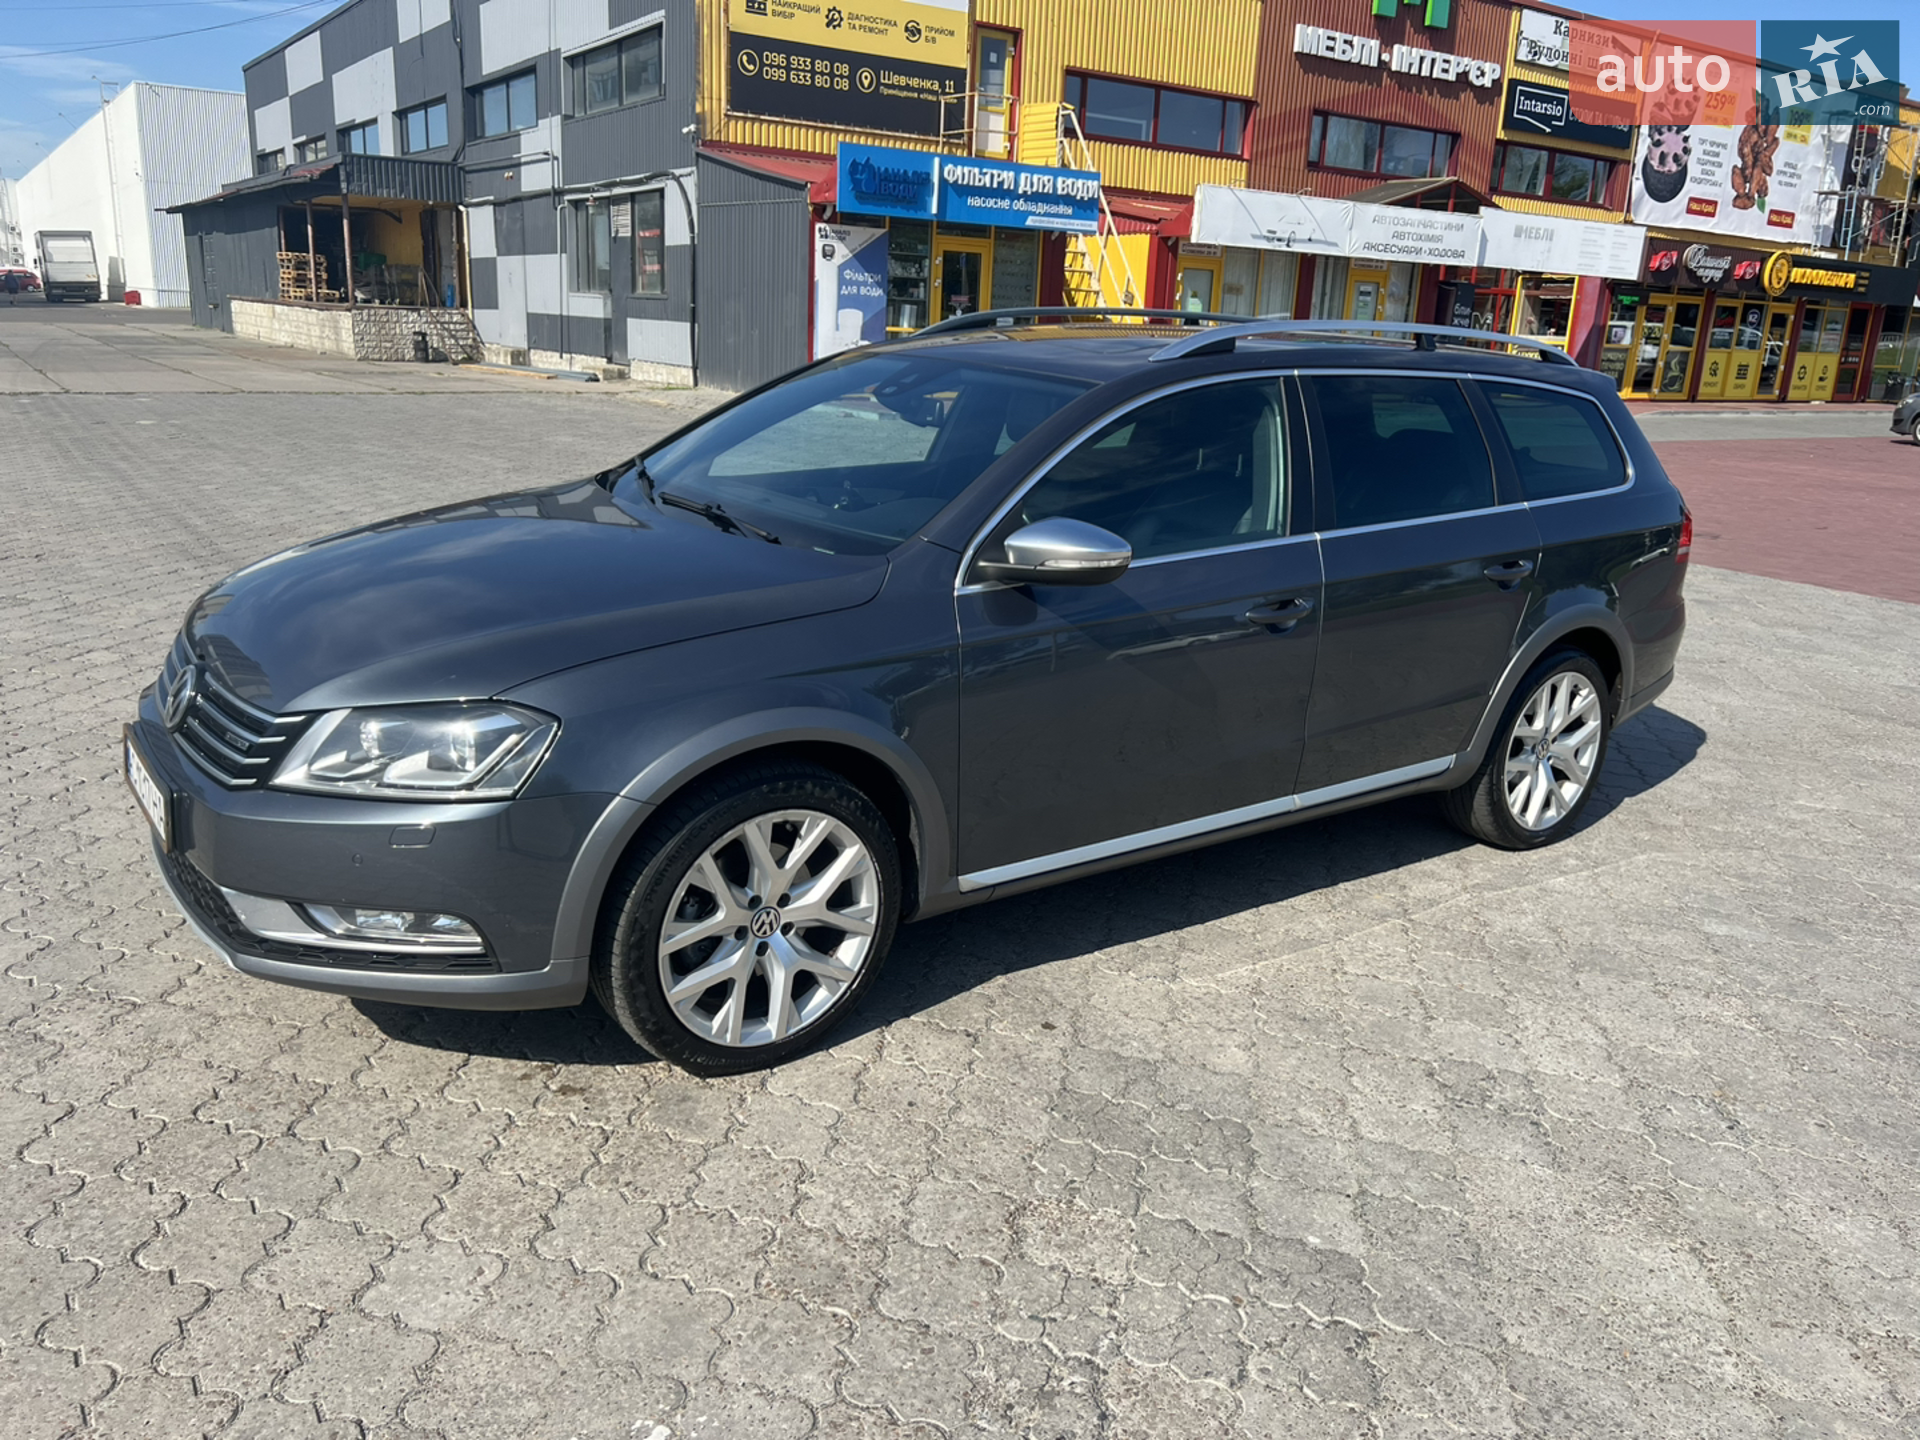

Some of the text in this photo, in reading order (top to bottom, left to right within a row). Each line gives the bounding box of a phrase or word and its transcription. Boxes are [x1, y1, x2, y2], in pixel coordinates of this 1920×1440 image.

[771, 10, 796, 20] ВИБІР
[847, 12, 898, 28] ДІАГНОСТИКА
[848, 23, 889, 36] ТА РЕМОНТ
[925, 25, 955, 37] ПРИЙОМ
[925, 35, 937, 44] Б/В
[1294, 24, 1380, 67] МЕБЛІ
[1528, 39, 1583, 66] Рулонні
[763, 51, 849, 76] 096 933 80 08
[763, 66, 849, 91] 099 633 80 08
[880, 70, 955, 93] Шевченка, 11
[1519, 96, 1562, 116] Intarsio
[944, 164, 1100, 200] ФІЛЬТРИ ДЛЯ ВОДИ
[967, 195, 1073, 216] насосне обладнання
[1372, 215, 1464, 232] АВТОЗАПЧАСТИНИ
[1392, 230, 1444, 244] АВТОХІМІЯ
[1362, 242, 1466, 259] АКСЕСУАРИ ХОДОВА
[843, 269, 882, 284] Фільтри
